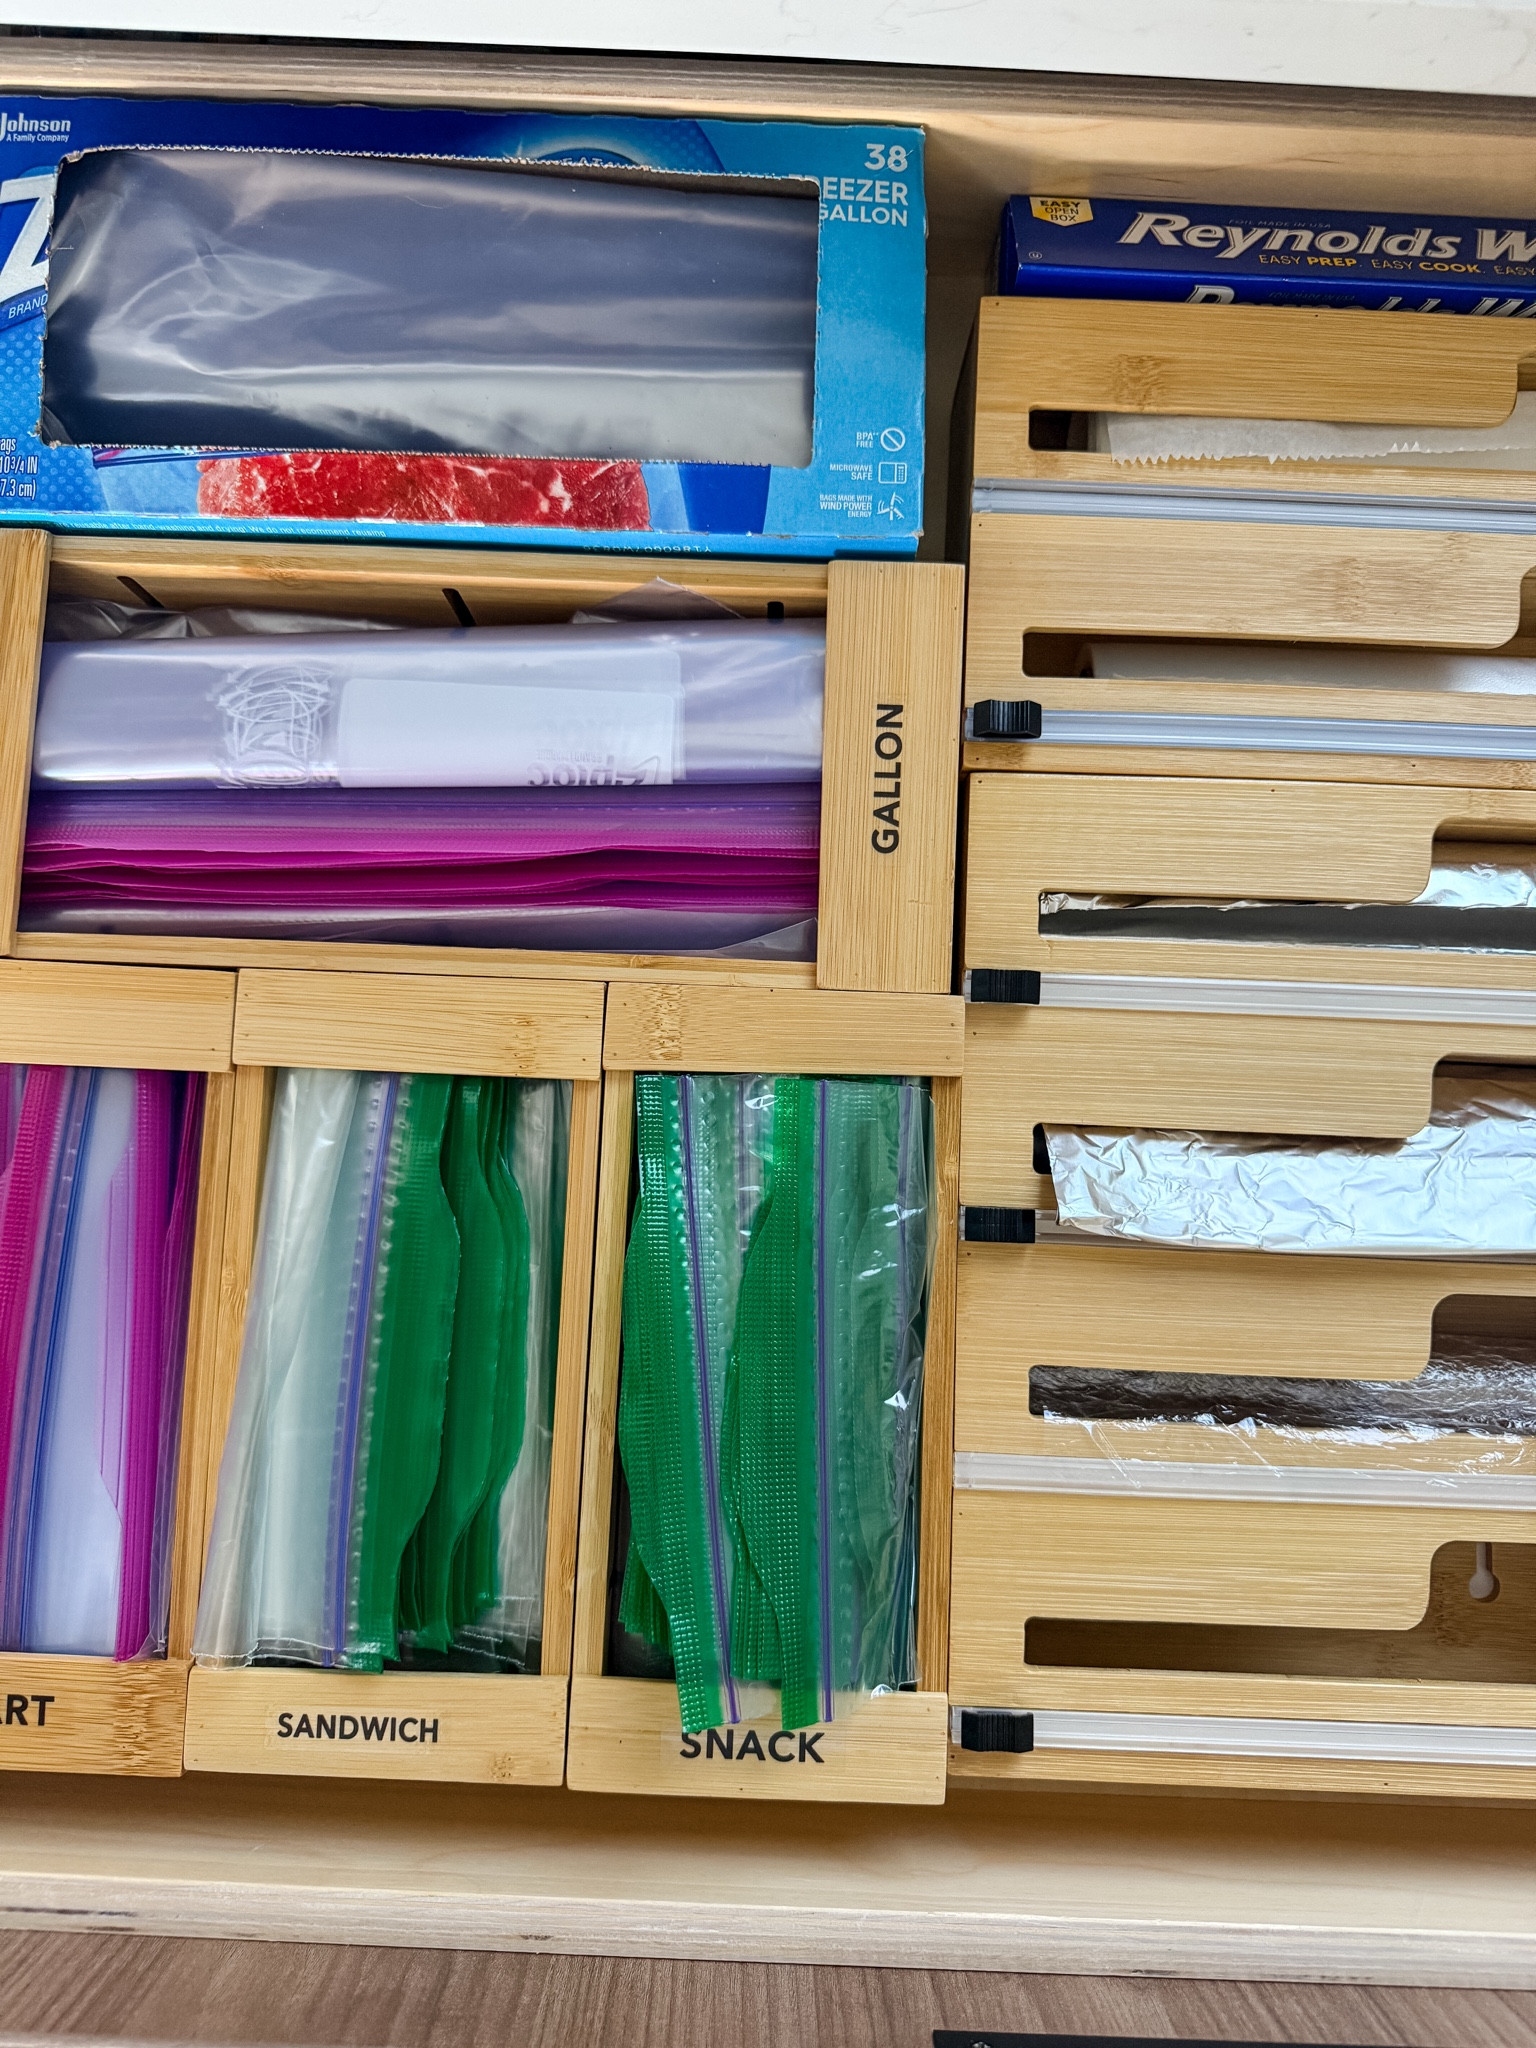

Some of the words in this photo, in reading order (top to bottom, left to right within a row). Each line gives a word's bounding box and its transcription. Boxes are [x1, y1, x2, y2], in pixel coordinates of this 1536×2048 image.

[0, 112, 72, 141] Johnson
[6, 133, 12, 142] A
[13, 133, 36, 143] Family
[37, 133, 70, 143] Company
[863, 143, 909, 173] 38
[788, 174, 909, 206] EEZER
[1039, 200, 1081, 208] EASY
[1044, 206, 1079, 215] OPEN
[1050, 214, 1077, 222] BOX
[1115, 211, 1463, 260] Reynolds
[1258, 254, 1301, 265] EASY
[1371, 259, 1413, 270] EASY
[1494, 265, 1536, 276] EASY
[8, 294, 49, 319] BRAND
[856, 440, 873, 448] FREE
[27, 455, 38, 474] IN
[829, 463, 873, 472] MICROWAVE
[851, 472, 873, 481] SAFE
[18, 479, 36, 501] cm)
[820, 501, 842, 511] WIND
[843, 502, 873, 511] POWER
[847, 510, 872, 518] ENERGY
[871, 703, 904, 854] GALLON
[0, 1693, 55, 1727] RT
[276, 1712, 439, 1743] SANDWICH
[679, 1729, 826, 1763] SNACK
